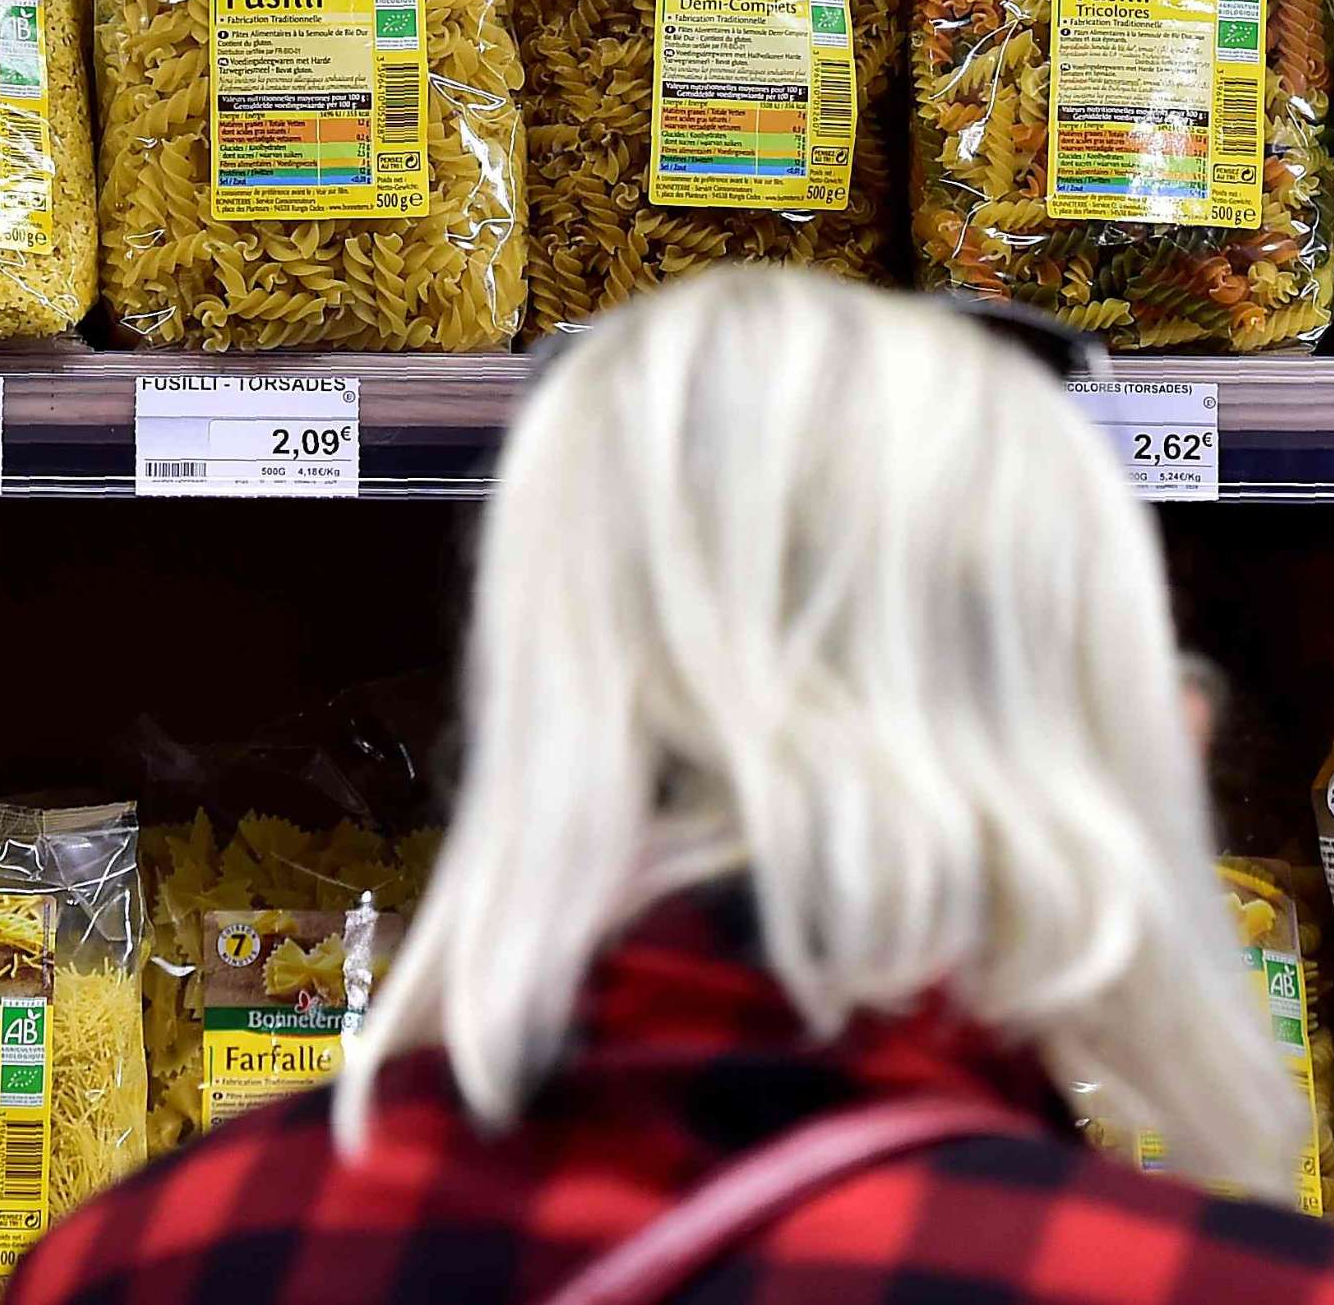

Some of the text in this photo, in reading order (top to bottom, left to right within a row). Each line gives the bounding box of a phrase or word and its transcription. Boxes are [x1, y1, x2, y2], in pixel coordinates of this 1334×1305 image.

[1077, 5, 1150, 19] Tricolores
[1124, 383, 1192, 395] (TORSADES)
[231, 934, 246, 956] 7
[226, 1045, 331, 1072] Farfalle
